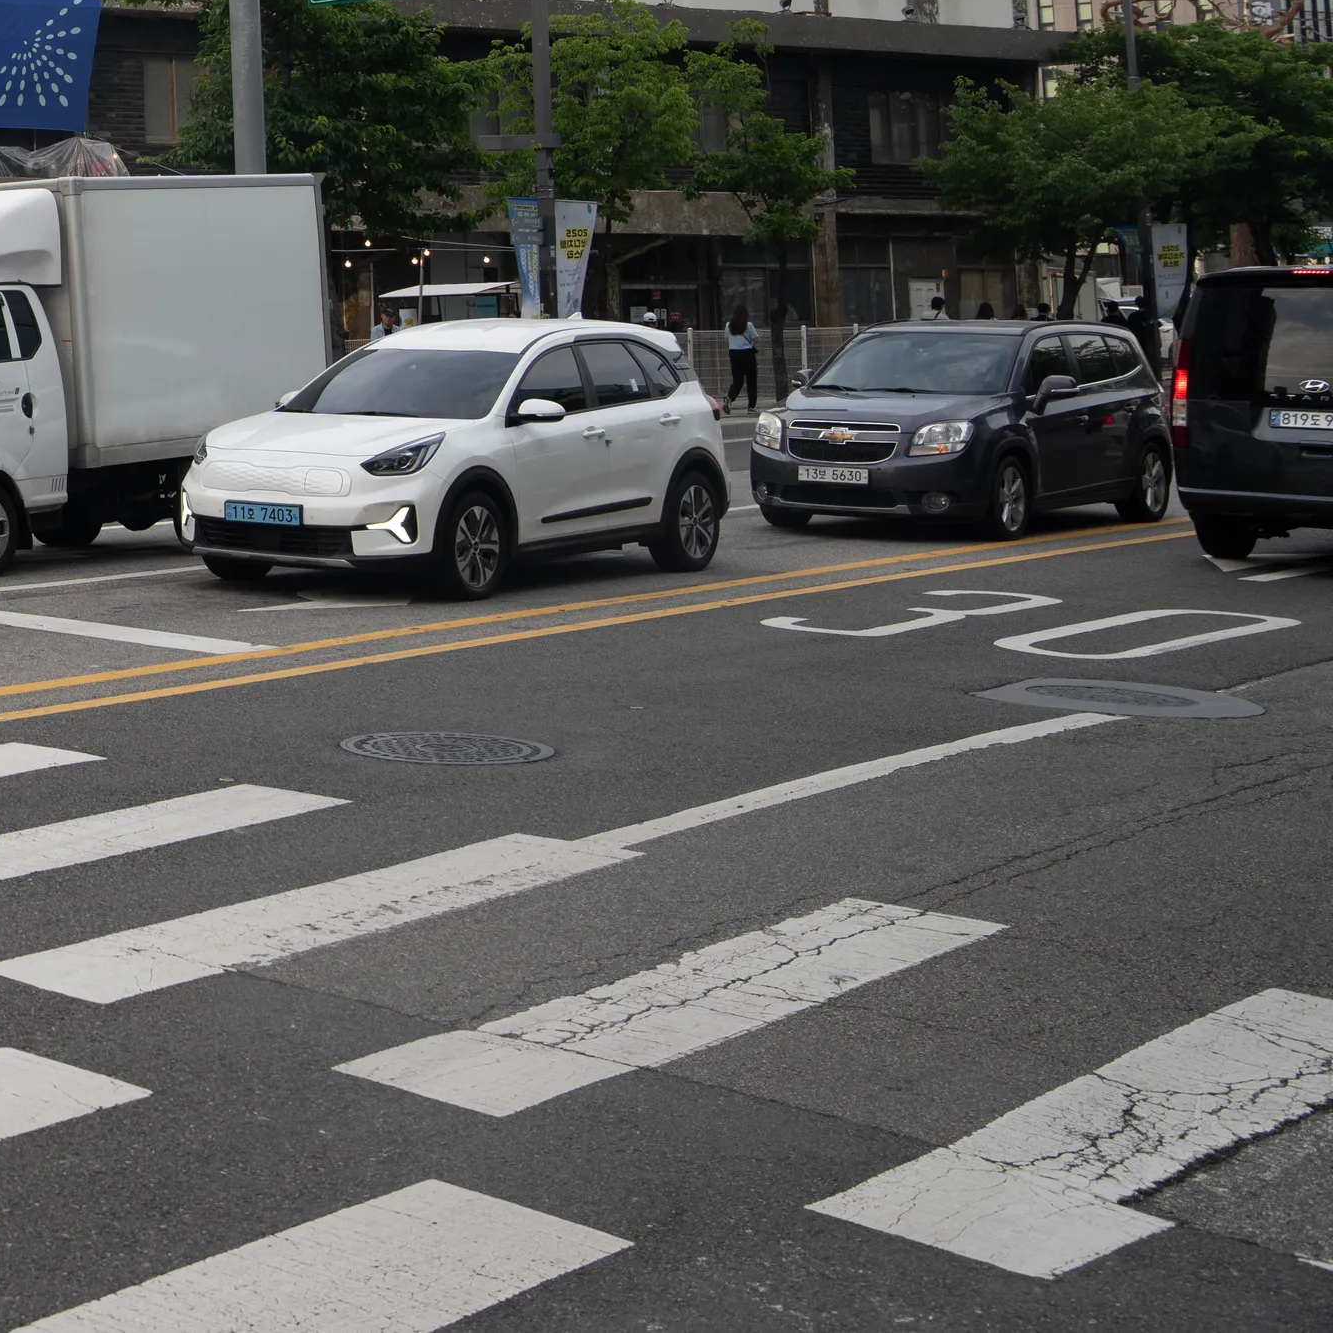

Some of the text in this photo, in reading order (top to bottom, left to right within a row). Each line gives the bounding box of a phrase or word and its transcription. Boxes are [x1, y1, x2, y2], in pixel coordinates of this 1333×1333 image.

[1282, 413, 1320, 426] 819도
[832, 469, 861, 481] 5630
[232, 505, 293, 523] 11호 7403
